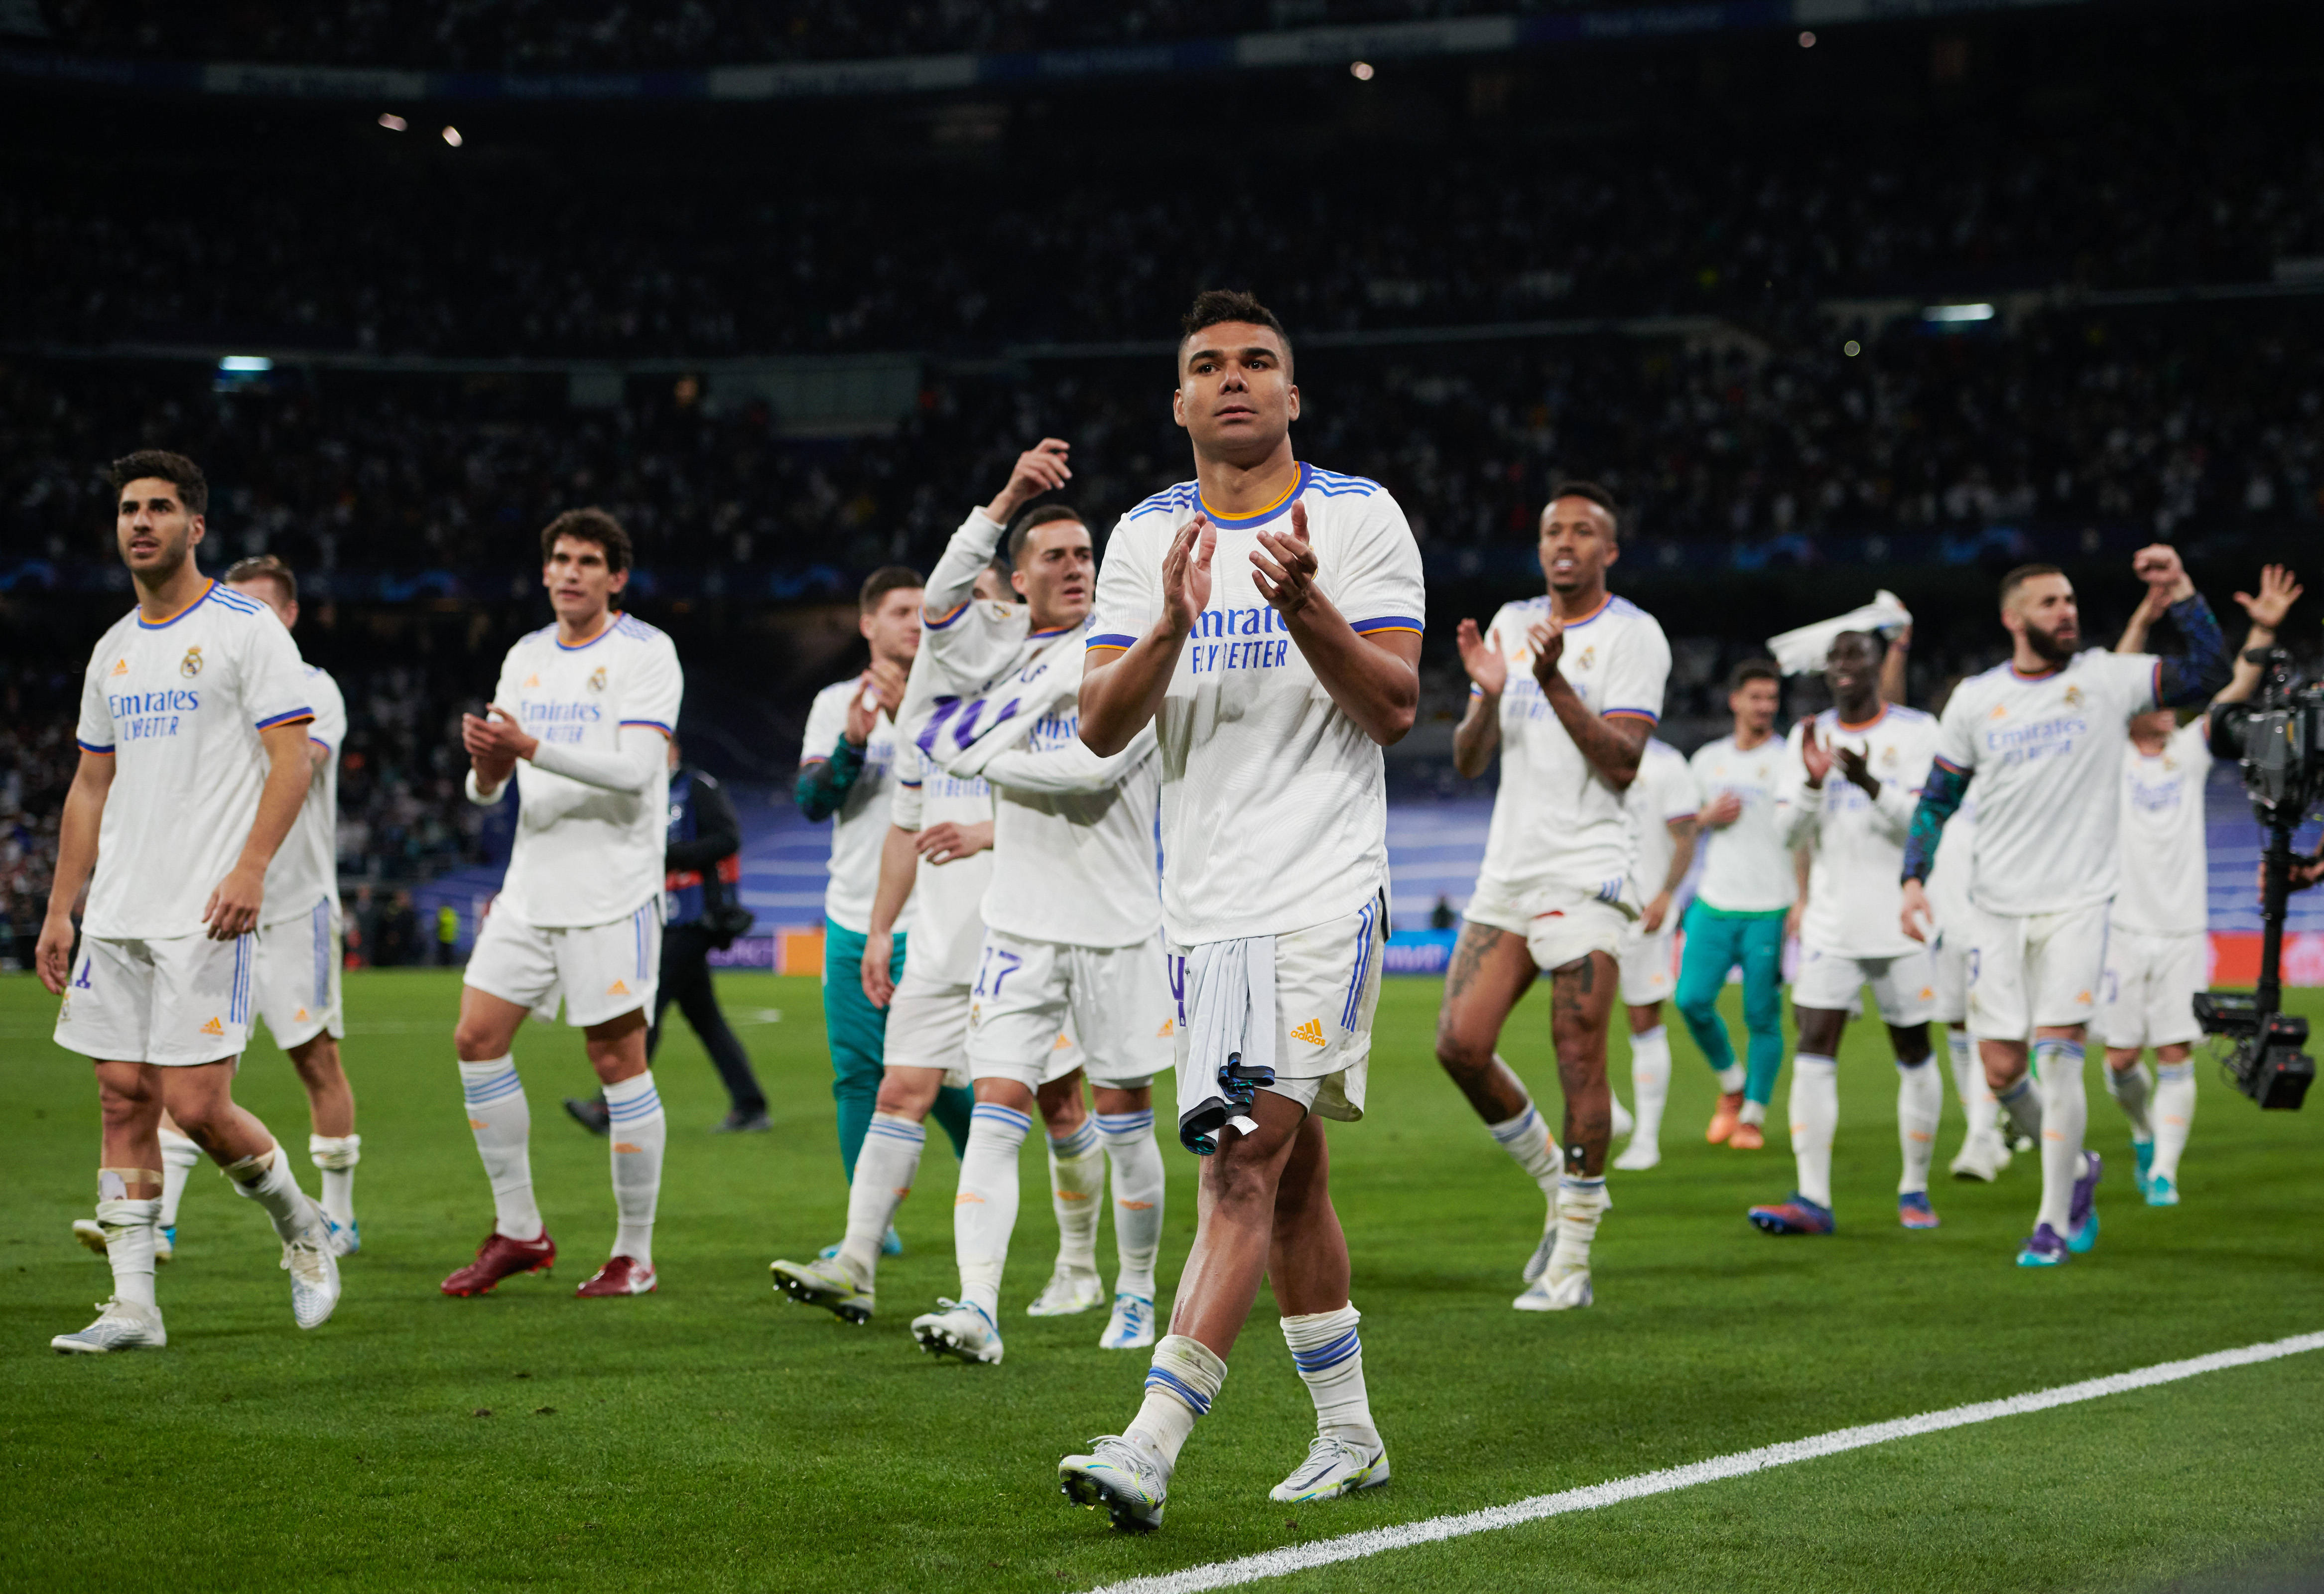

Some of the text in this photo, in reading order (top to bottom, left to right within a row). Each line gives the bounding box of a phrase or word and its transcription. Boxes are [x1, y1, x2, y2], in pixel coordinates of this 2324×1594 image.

[1223, 640, 1288, 670] ETTER
[109, 687, 200, 719] Emrates
[974, 946, 1023, 1001] 17
[1290, 1030, 1326, 1047] adidas
